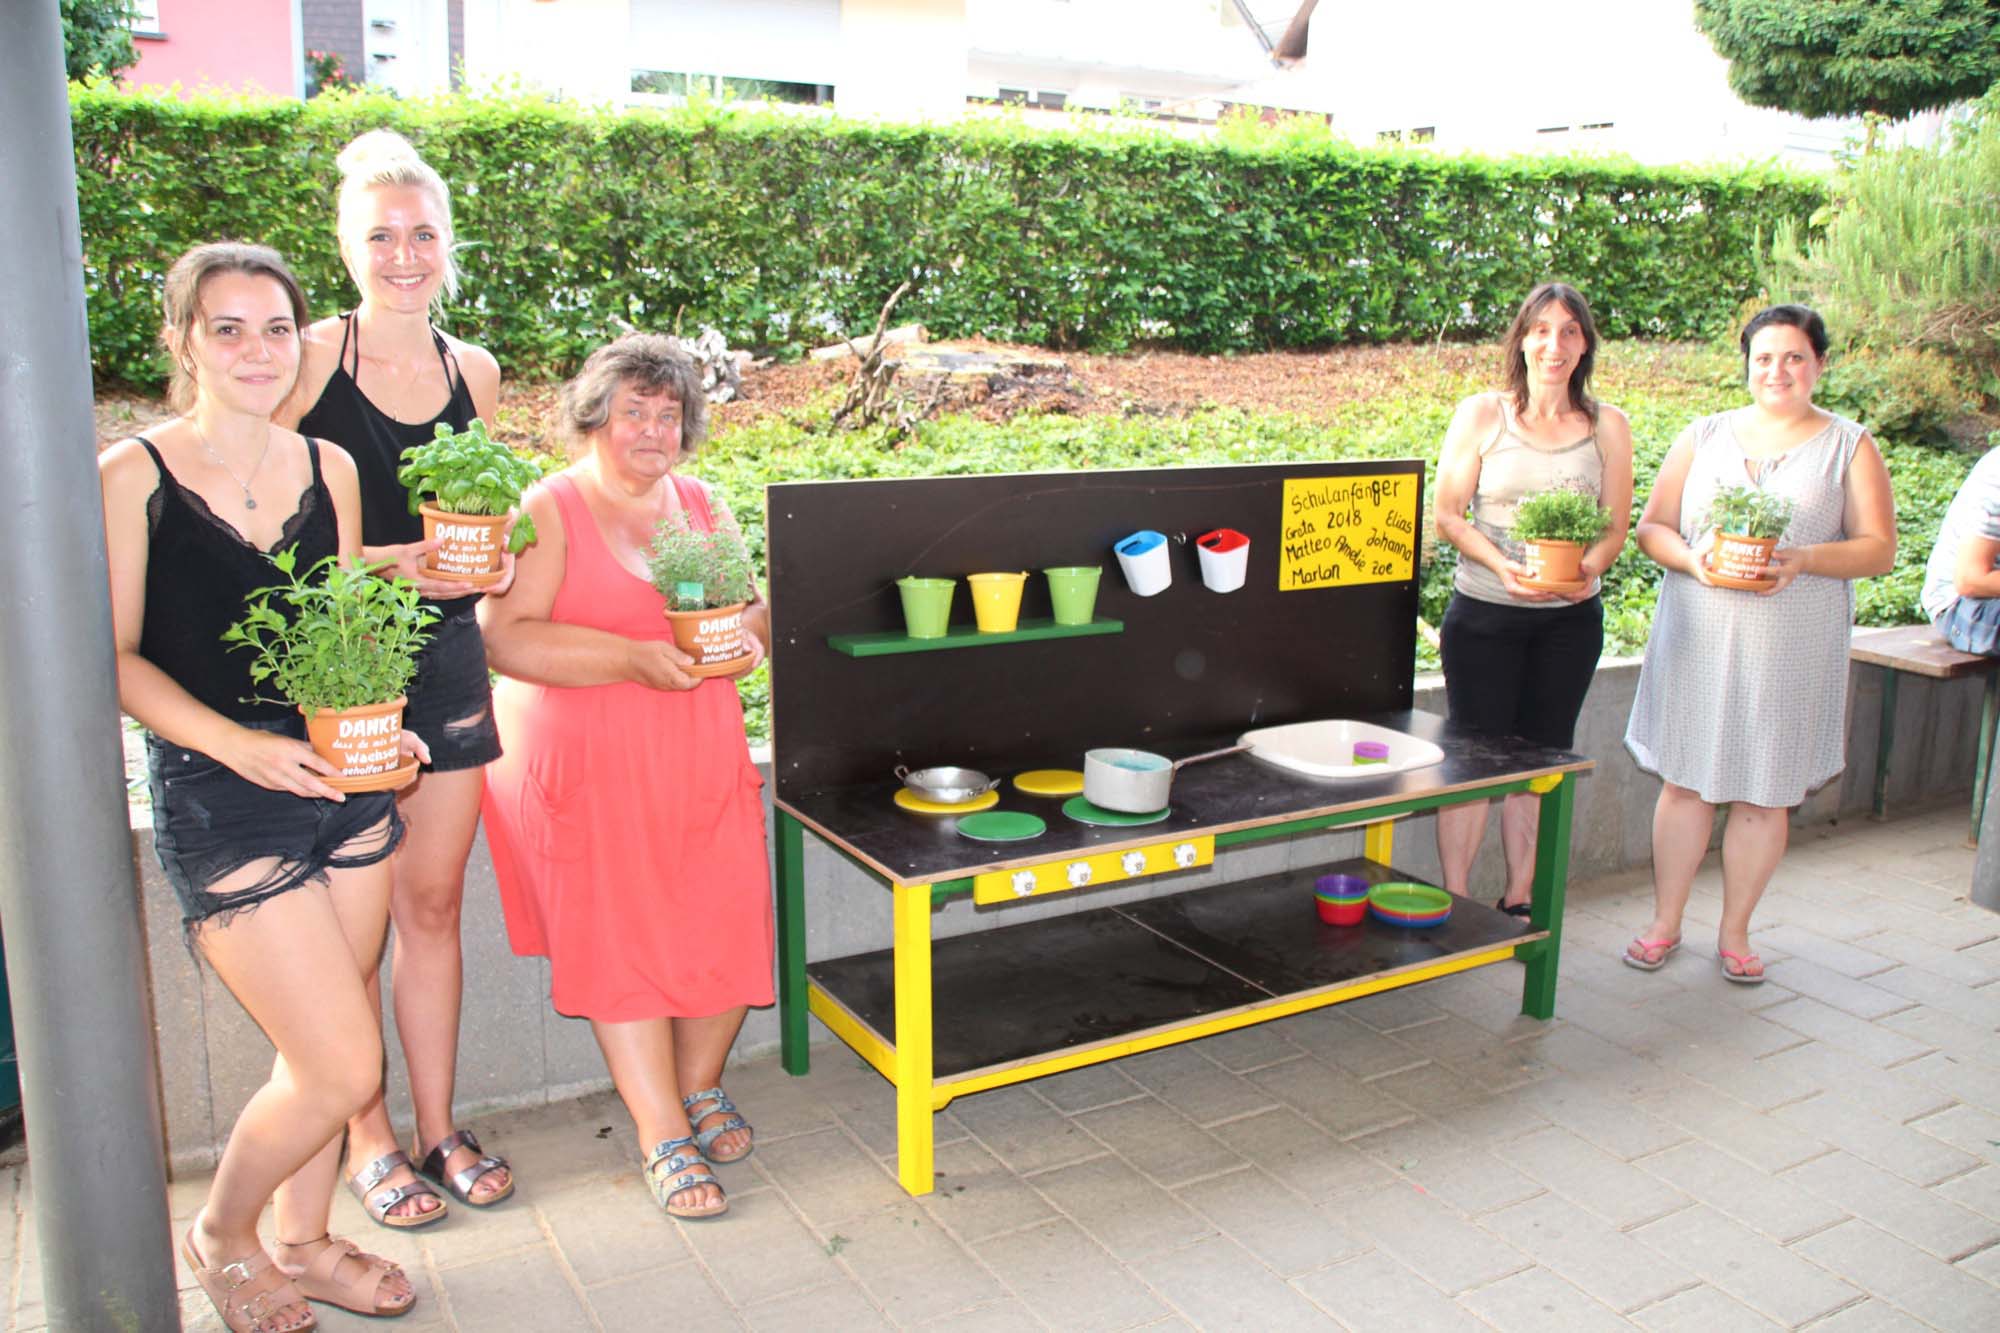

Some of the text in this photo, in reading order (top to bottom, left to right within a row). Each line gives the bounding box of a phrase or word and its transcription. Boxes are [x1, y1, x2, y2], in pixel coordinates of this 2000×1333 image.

[1292, 480, 1400, 514] Schulanfänger
[1286, 520, 1316, 540] Greta
[1327, 509, 1362, 529] 2018
[1385, 509, 1412, 534] Elias
[435, 523, 492, 542] DANKE
[1366, 528, 1412, 561] Johanna
[1285, 537, 1331, 563] Matteo
[1335, 535, 1366, 572] Amelie
[339, 713, 399, 737] DANKE
